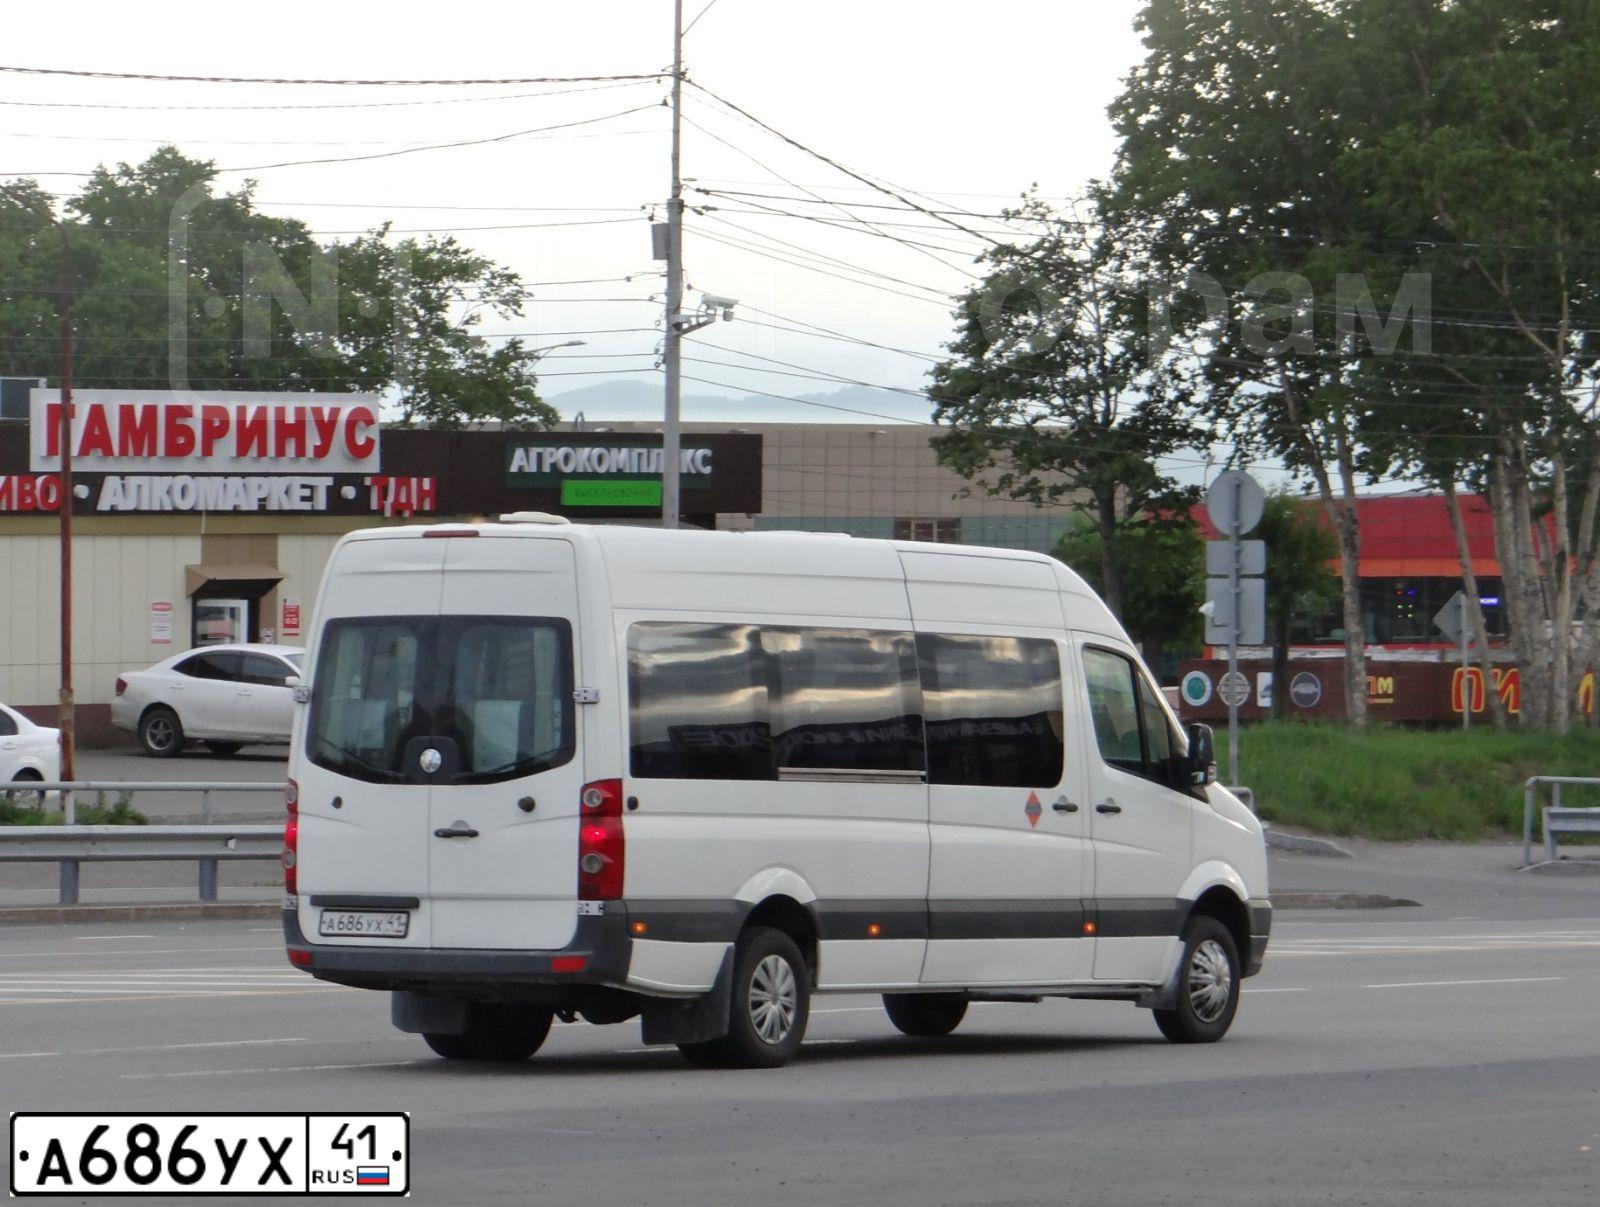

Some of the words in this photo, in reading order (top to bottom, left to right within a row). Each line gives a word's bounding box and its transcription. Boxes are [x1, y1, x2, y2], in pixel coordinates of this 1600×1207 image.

[45, 403, 376, 460] ГАМБРИНУС
[509, 446, 713, 474] АГРОКОМПЛКС
[97, 476, 334, 511] АЛКОМАРКЕТ
[364, 476, 436, 518] ТДН
